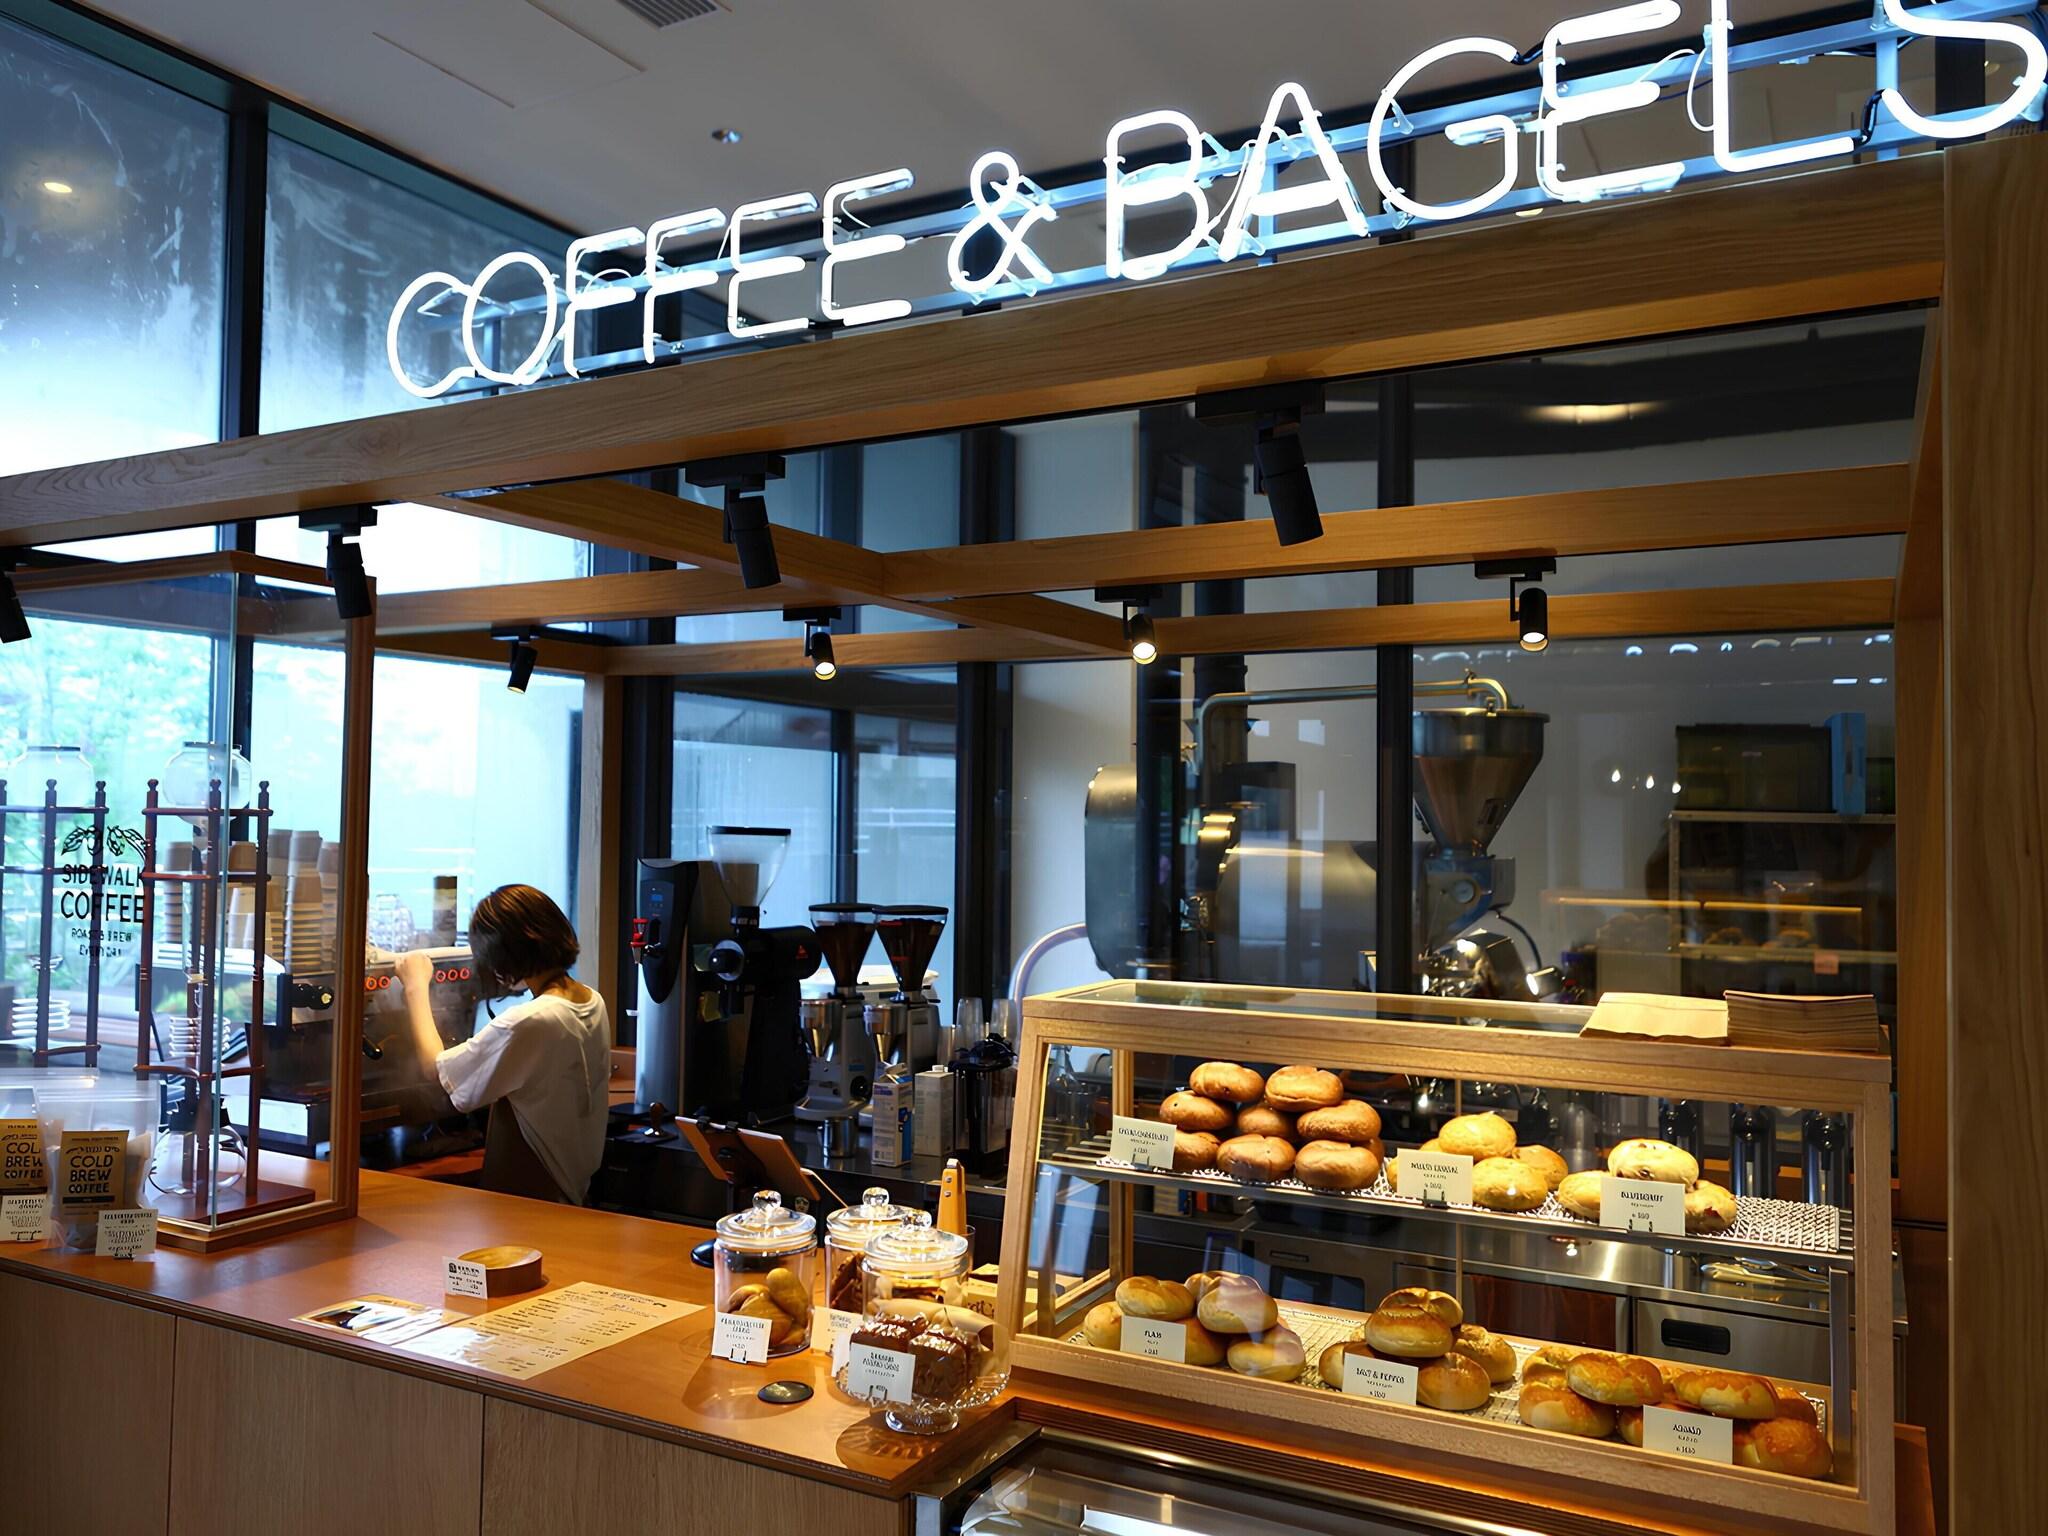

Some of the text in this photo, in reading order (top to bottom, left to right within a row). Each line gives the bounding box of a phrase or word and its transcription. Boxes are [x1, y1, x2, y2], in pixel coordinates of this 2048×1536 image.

[387, 0, 2048, 398] COFFEE & BAGELS
[6, 1142, 41, 1154] COL
[70, 1155, 113, 1168] COLD
[70, 1168, 112, 1182] BREW
[68, 1182, 110, 1194] COFFEE
